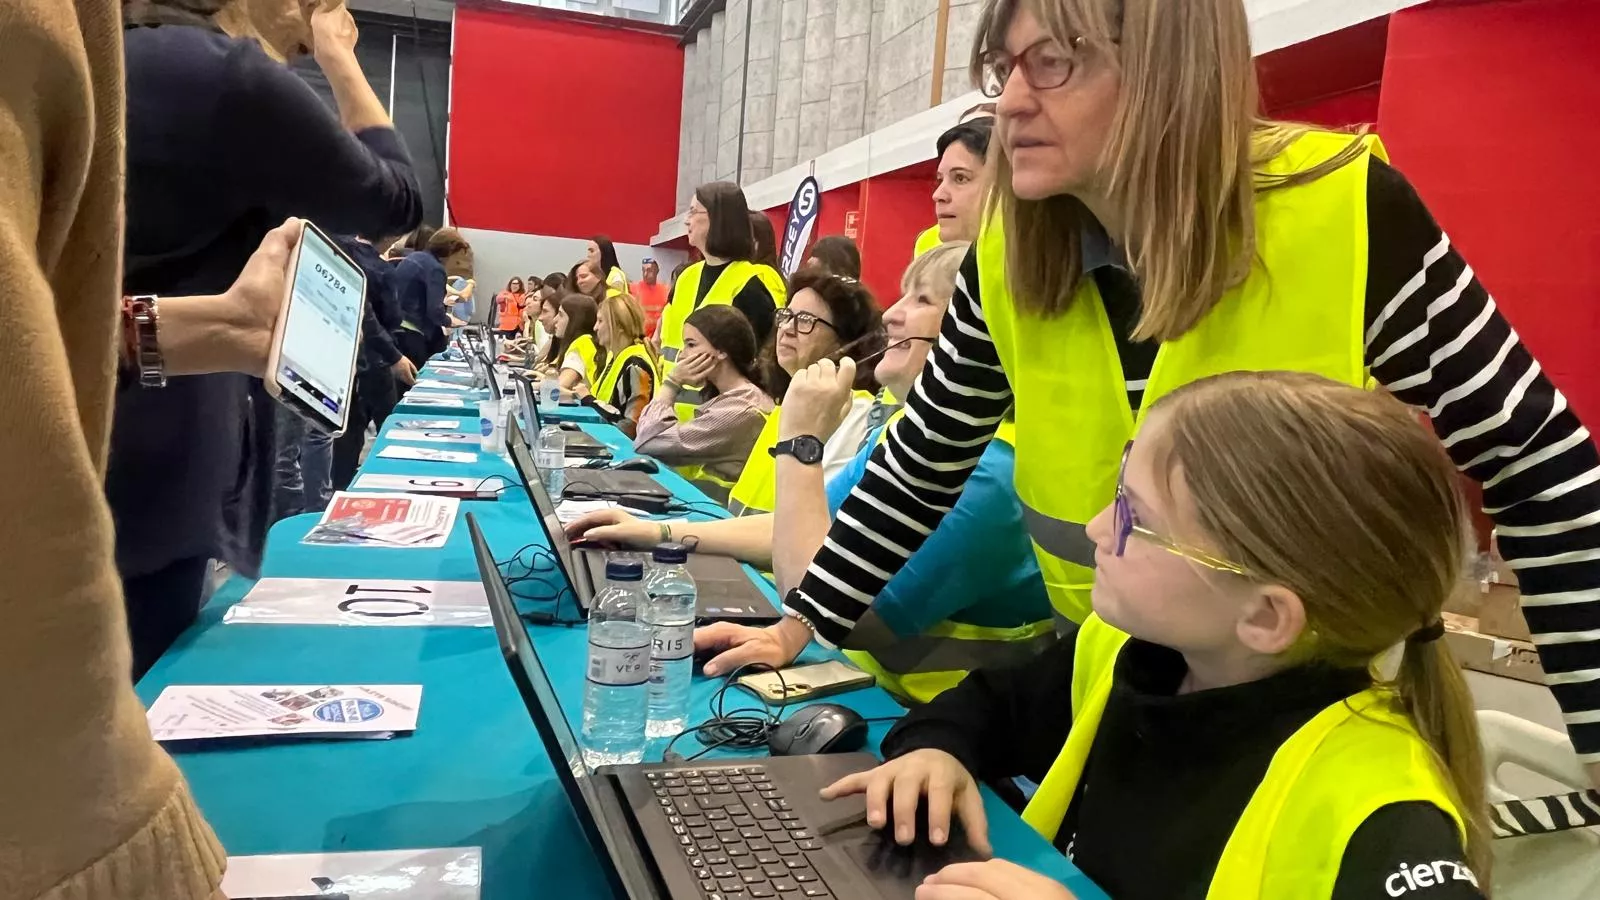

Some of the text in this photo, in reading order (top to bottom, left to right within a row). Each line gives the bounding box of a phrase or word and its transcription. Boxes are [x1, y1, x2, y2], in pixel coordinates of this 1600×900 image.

[315, 263, 347, 295] 06784
[408, 479, 464, 487] 9
[337, 584, 432, 617] 10
[653, 638, 683, 651] RIS
[616, 664, 641, 673] VER
